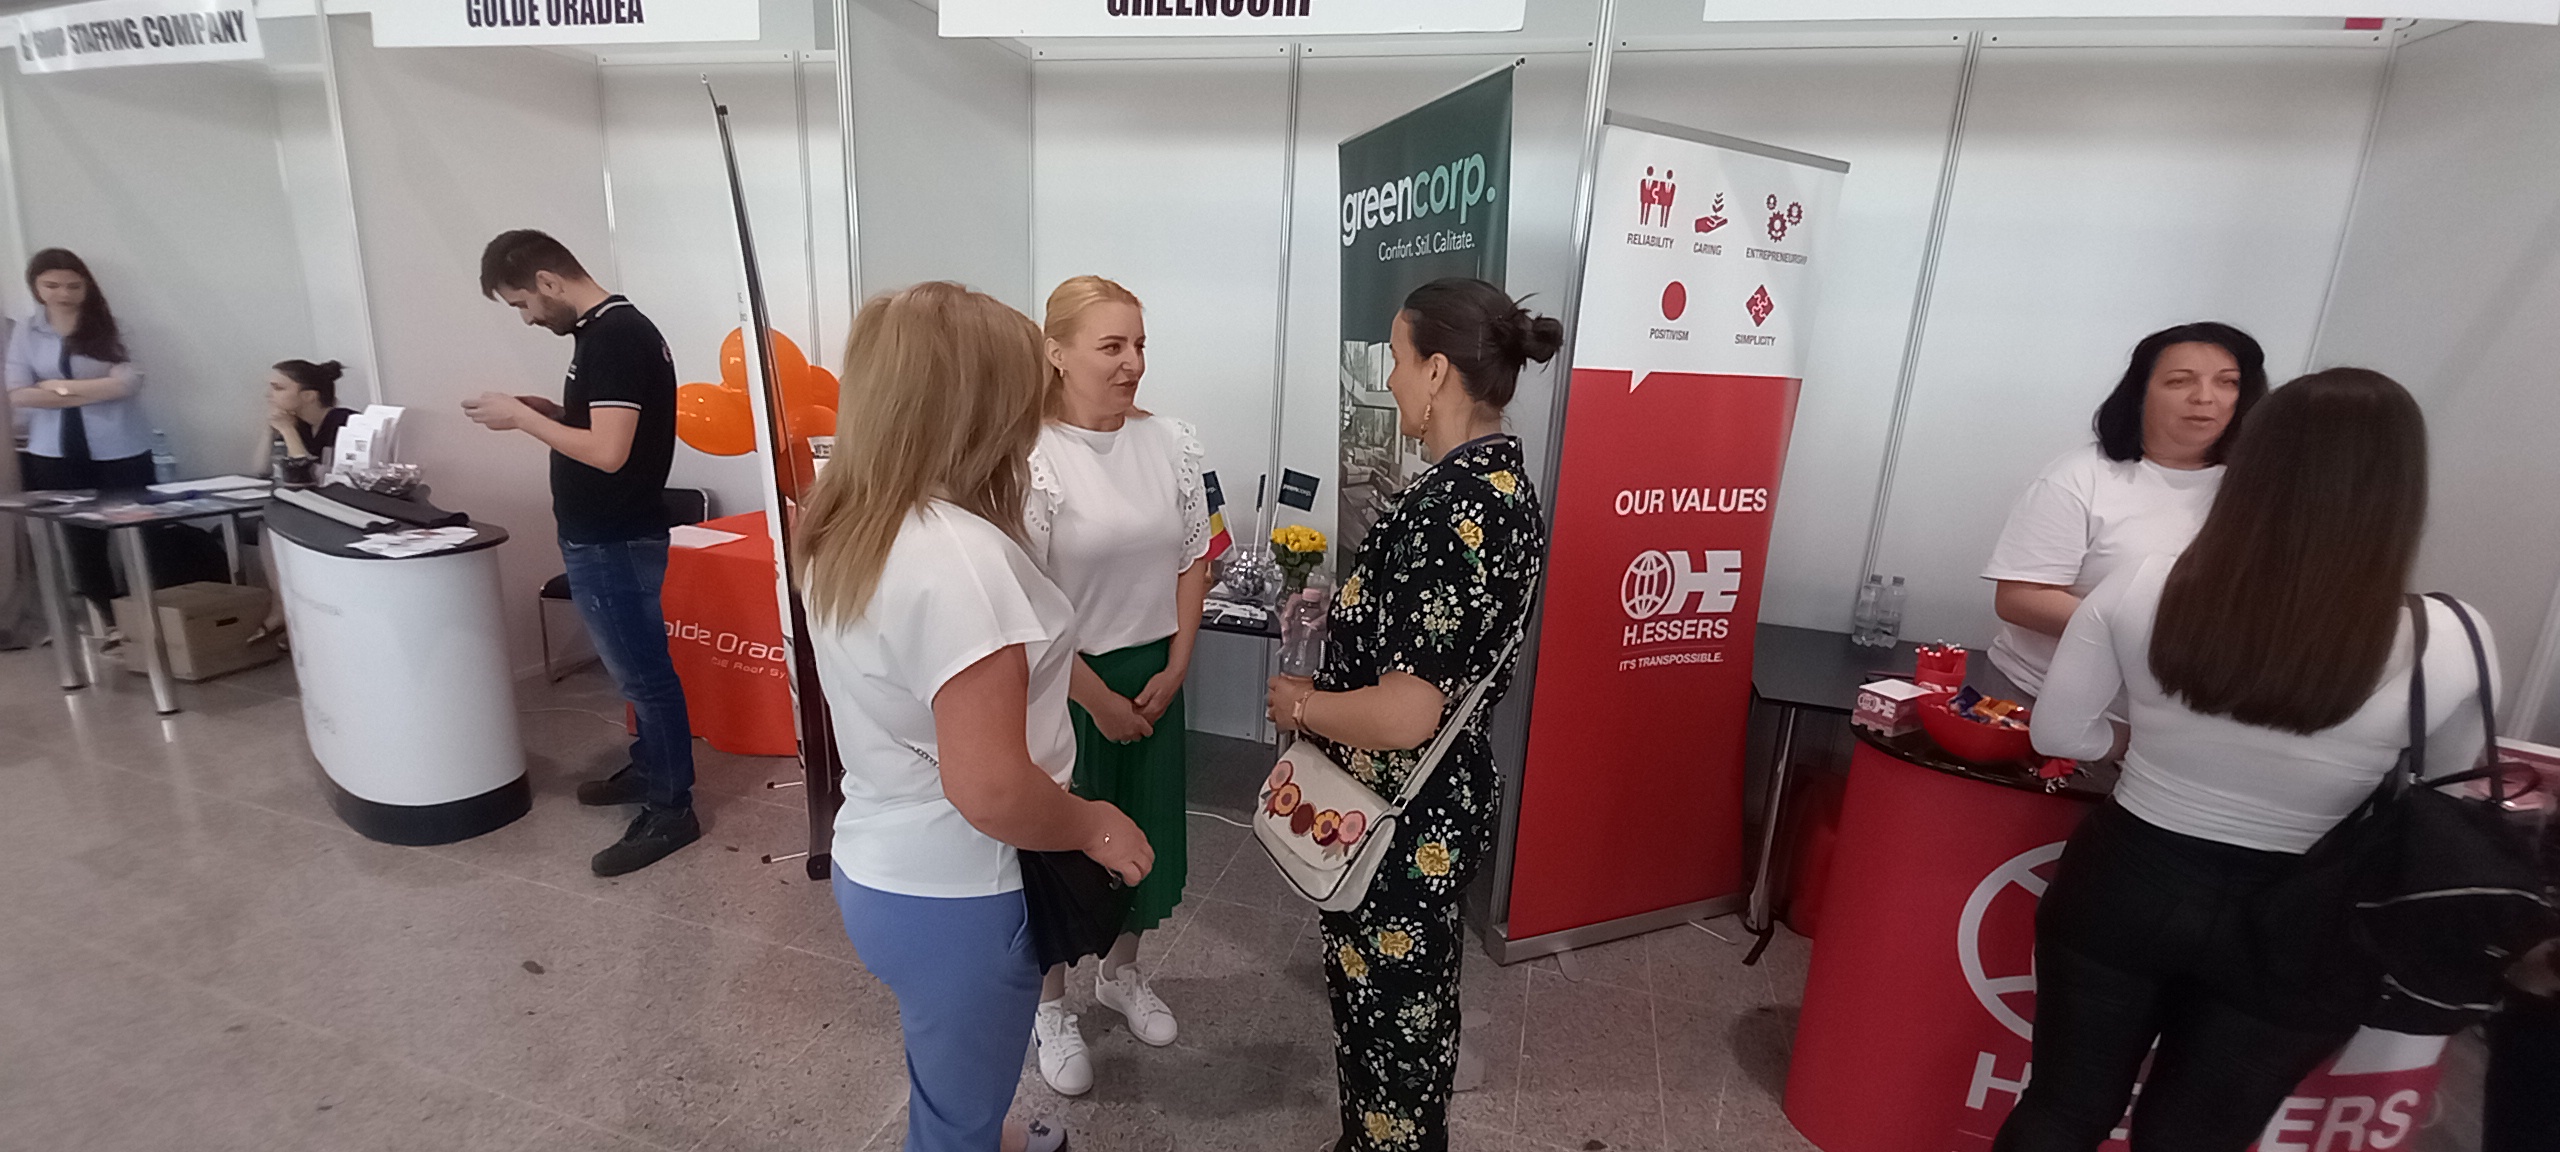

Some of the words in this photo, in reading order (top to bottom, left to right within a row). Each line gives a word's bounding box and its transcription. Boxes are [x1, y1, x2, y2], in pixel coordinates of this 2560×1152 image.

[67, 17, 144, 54] STAFFING
[142, 9, 248, 48] COMPANY
[1627, 233, 1674, 249] RELIABILITY
[1693, 242, 1722, 256] CARING
[1649, 328, 1690, 341] POSITIVISM
[1734, 334, 1776, 347] SIMPLICITY
[1615, 489, 1665, 516] OUR
[1671, 488, 1768, 513] VALUES
[664, 620, 712, 646] olde
[1622, 619, 1729, 647] H.ESSERS
[1638, 652, 1724, 668] TRANSPOSSIBLE.
[770, 668, 787, 680] Sy
